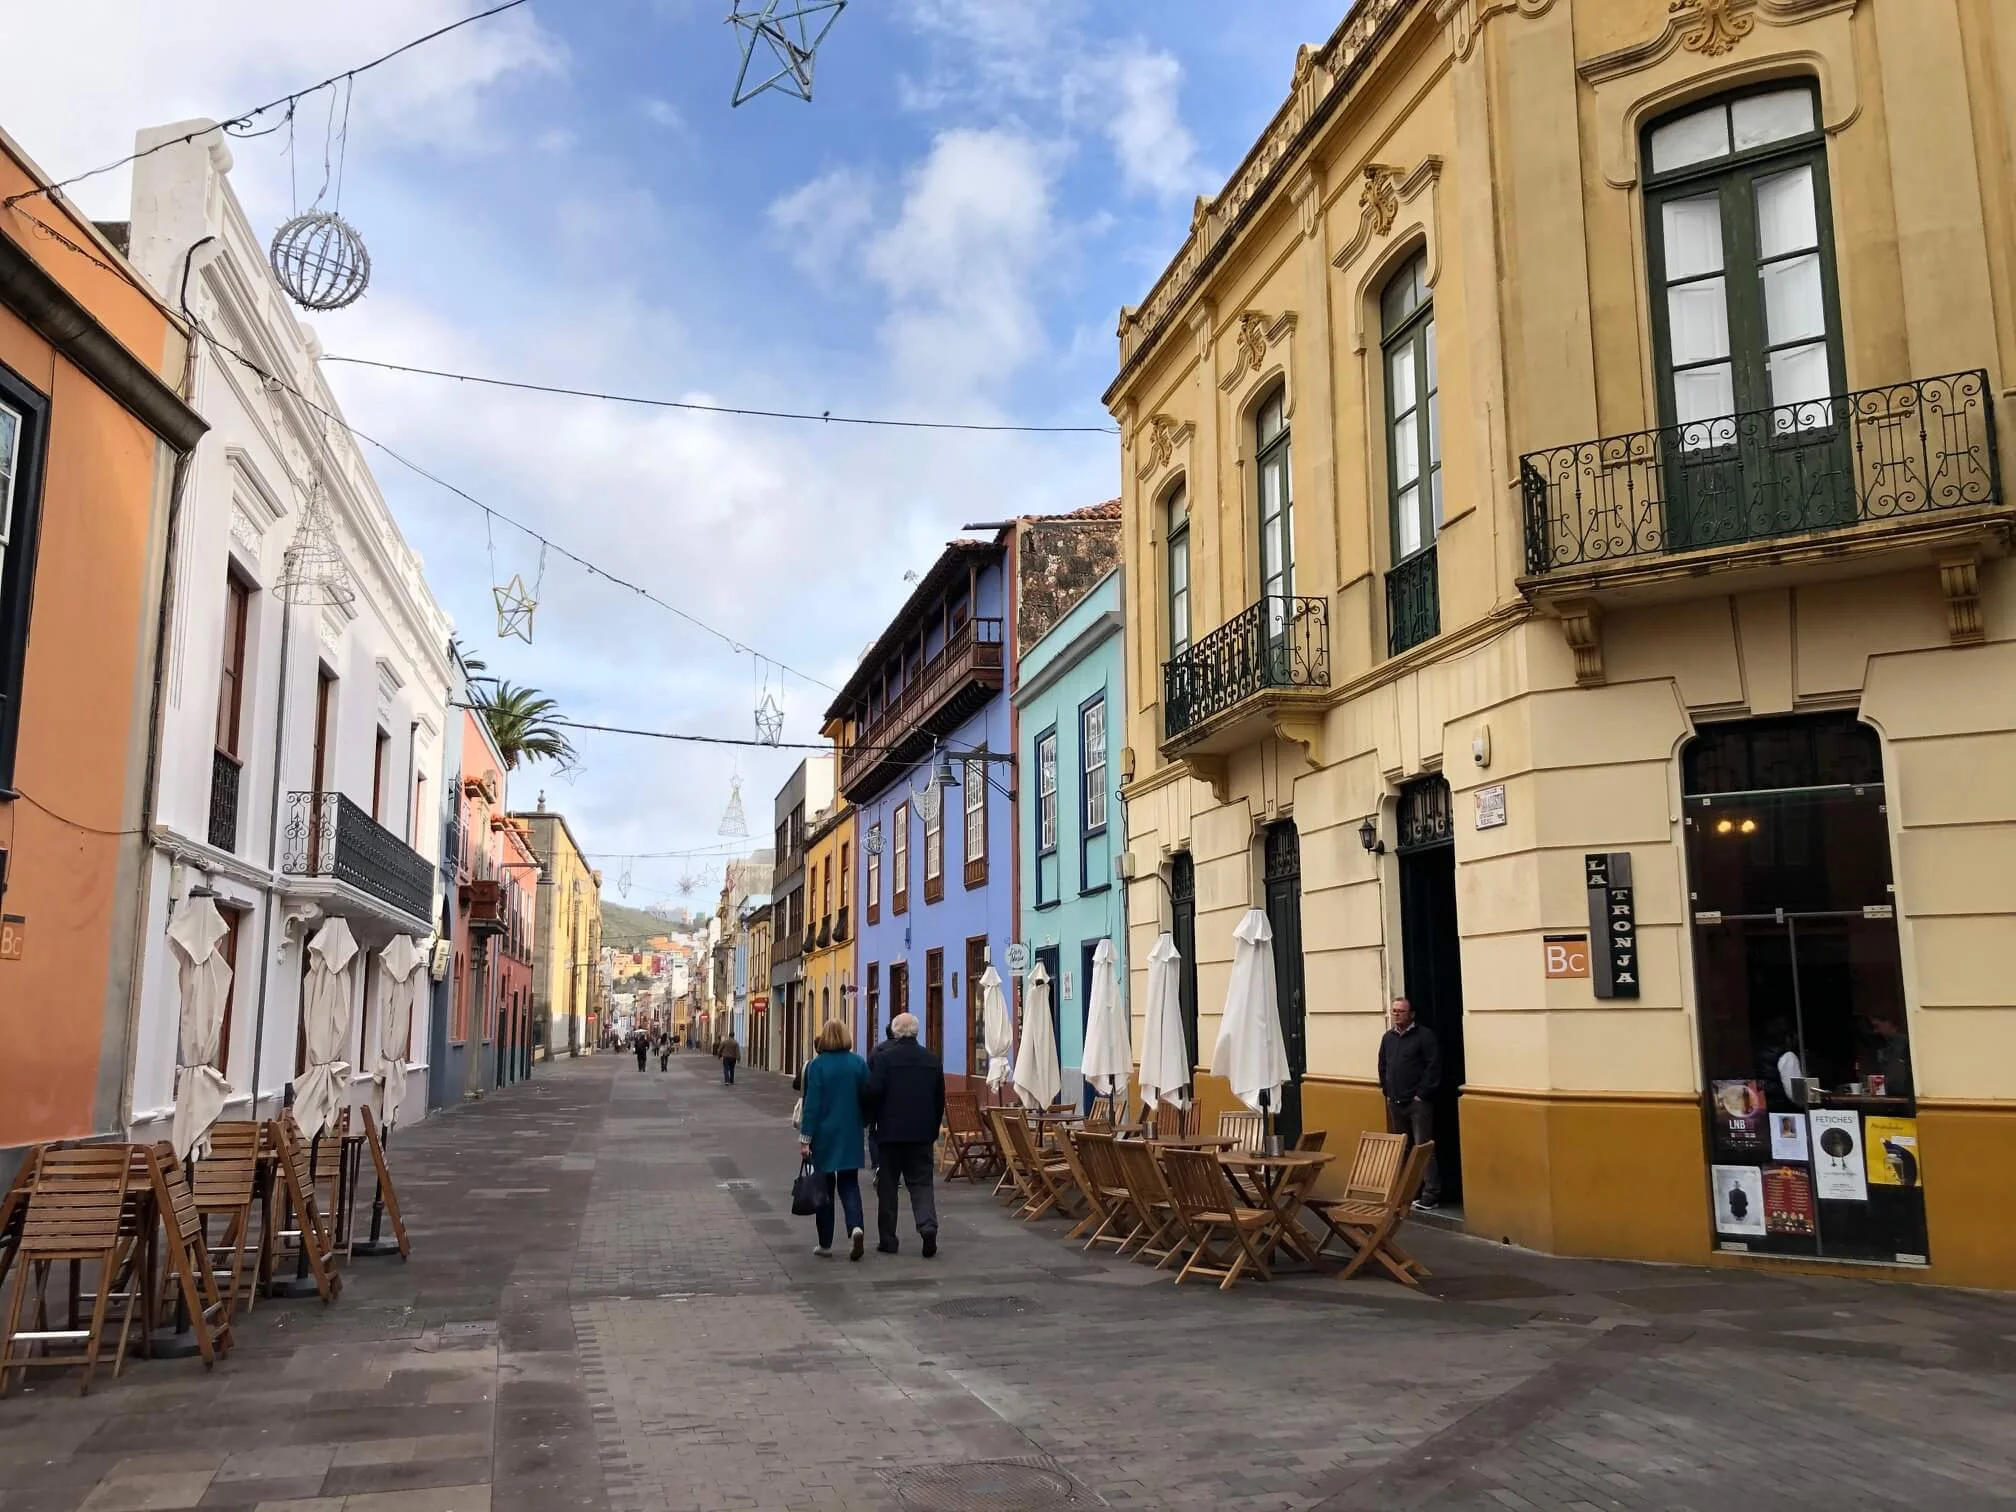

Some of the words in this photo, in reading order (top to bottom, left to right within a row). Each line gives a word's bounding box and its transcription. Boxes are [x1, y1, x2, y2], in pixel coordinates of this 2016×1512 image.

[1266, 799, 1273, 812] 77
[1588, 860, 1608, 885] LA
[1611, 889, 1636, 984] TRONJA
[1, 927, 21, 955] Bc
[1547, 945, 1585, 973] Bc
[1815, 1115, 1853, 1124] FETICHES
